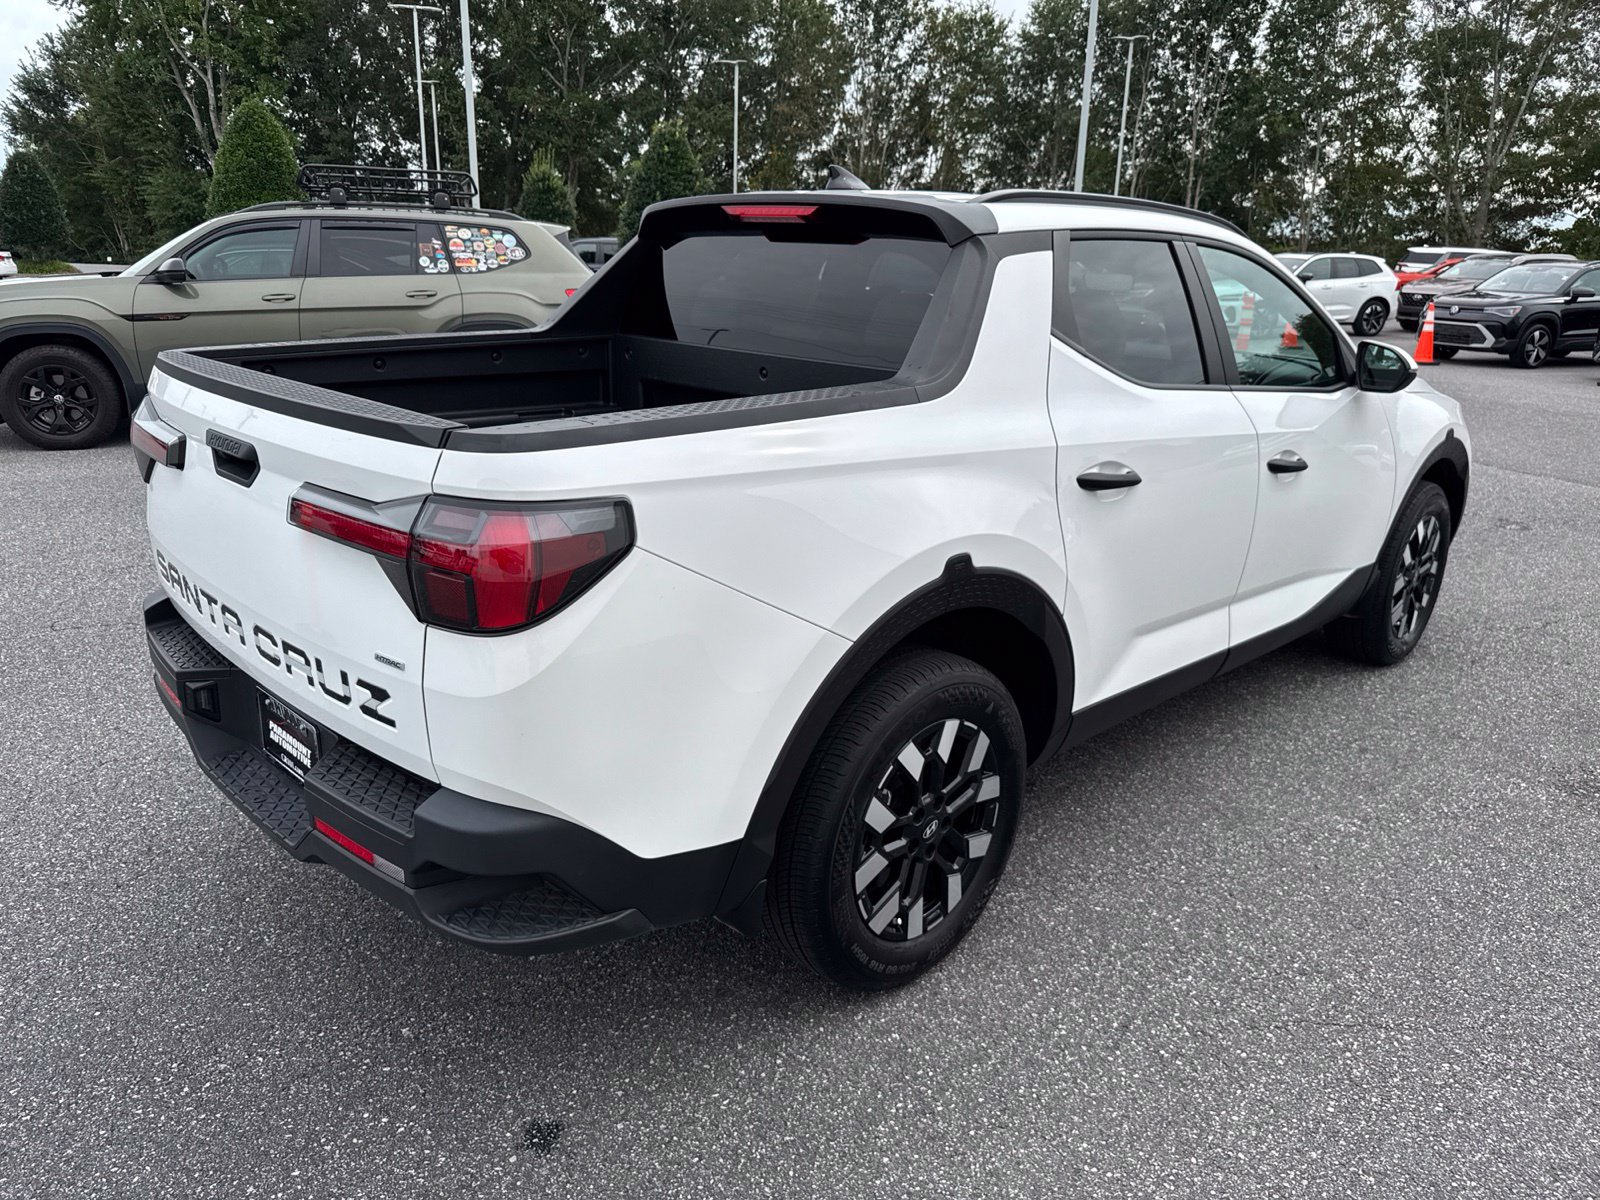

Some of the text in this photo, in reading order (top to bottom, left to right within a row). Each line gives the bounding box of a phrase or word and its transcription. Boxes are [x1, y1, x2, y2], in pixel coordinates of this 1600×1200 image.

[155, 548, 397, 729] SANTA CRUZ
[375, 654, 403, 669] HTRAC
[269, 720, 312, 759] PARAMOUNT
[269, 730, 312, 769] AUTOMOTIVE
